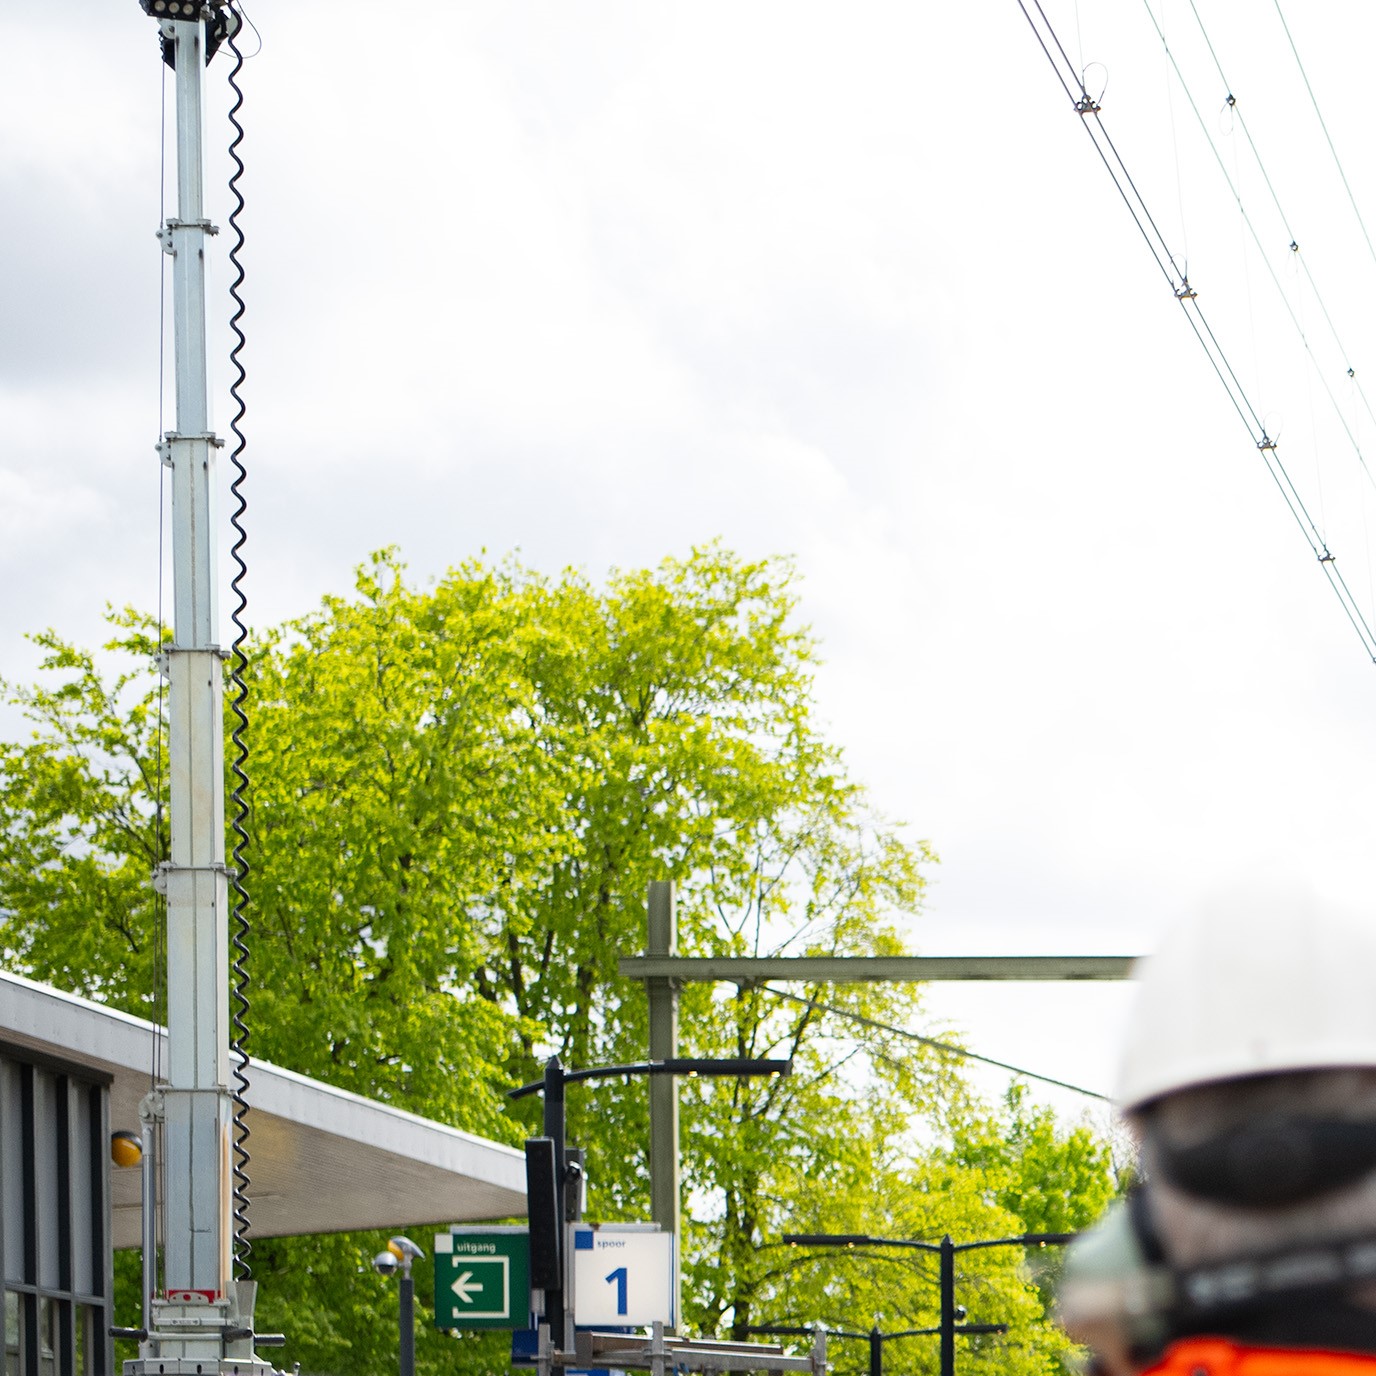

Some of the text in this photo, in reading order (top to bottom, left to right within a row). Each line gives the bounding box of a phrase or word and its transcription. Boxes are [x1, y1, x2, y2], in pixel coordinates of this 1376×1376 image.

[456, 1242, 496, 1255] uitgang
[597, 1239, 626, 1249] spoor
[605, 1267, 628, 1316] 1
